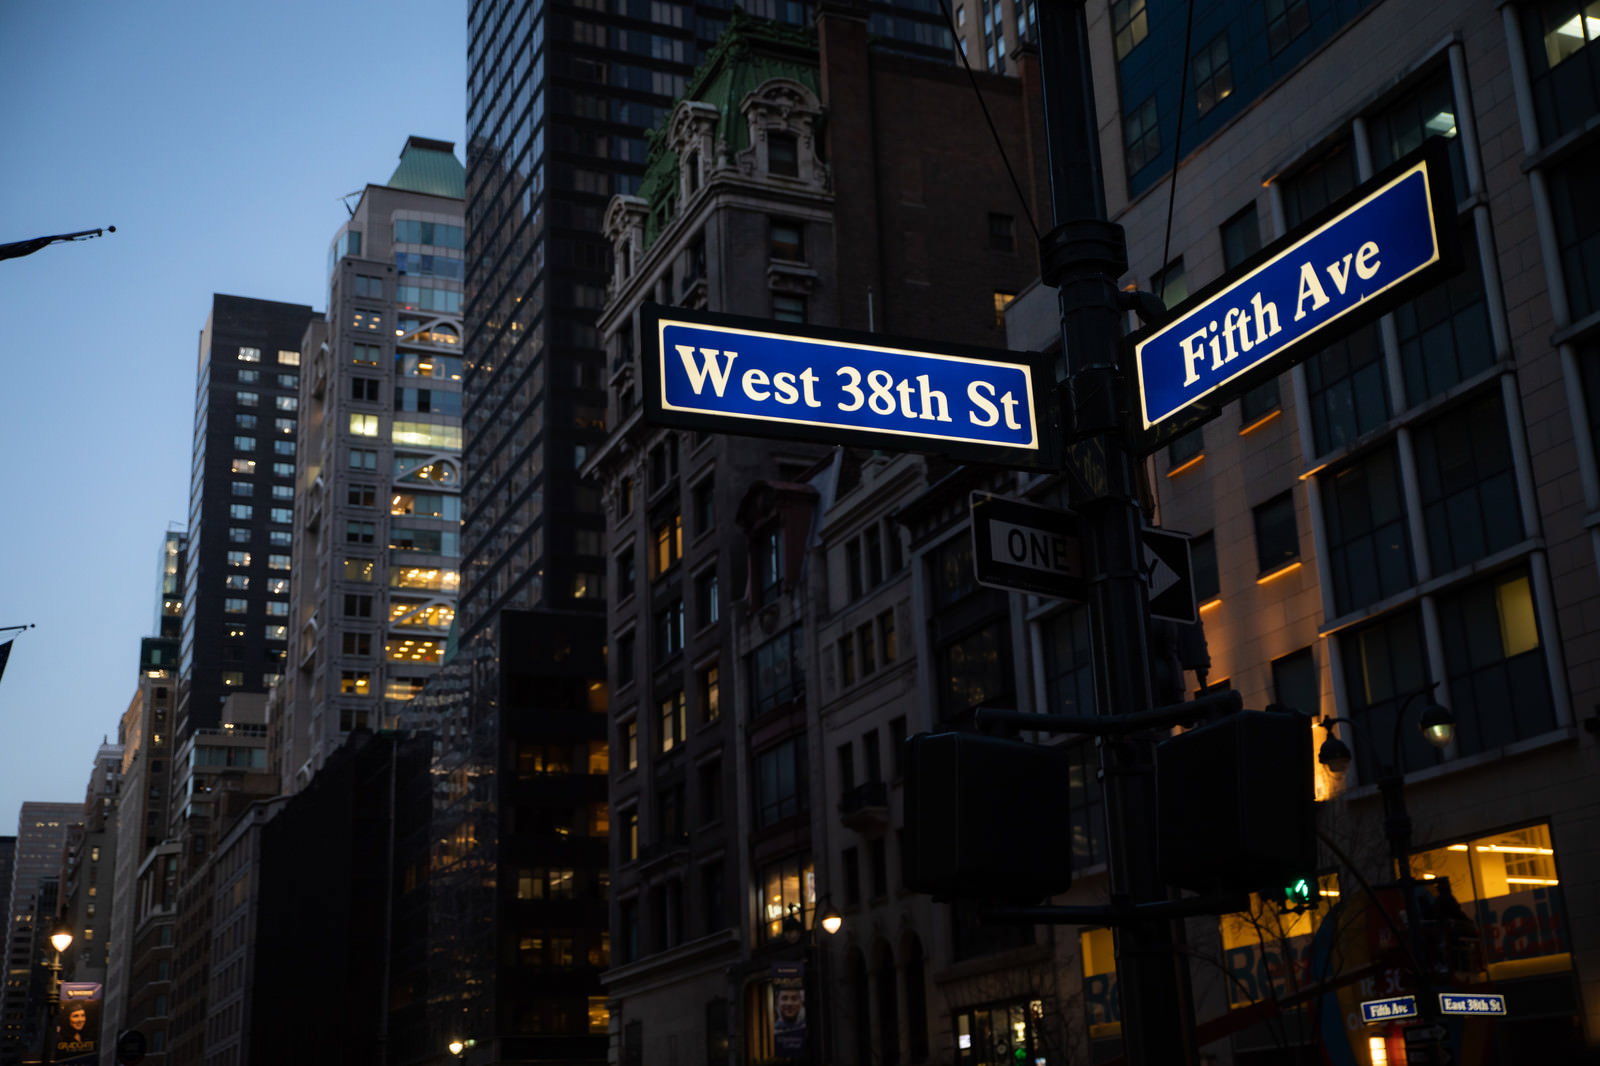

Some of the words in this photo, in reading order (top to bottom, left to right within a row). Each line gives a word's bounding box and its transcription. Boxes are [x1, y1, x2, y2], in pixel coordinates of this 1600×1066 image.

[1179, 291, 1282, 387] Fifth
[1294, 241, 1382, 322] Ave
[674, 344, 820, 408] West
[836, 365, 953, 423] 38th
[966, 380, 1022, 431] St
[1007, 528, 1071, 572] ONE
[1370, 1003, 1391, 1018] Fifth
[1444, 998, 1467, 1011] East
[1489, 1000, 1502, 1012] St
